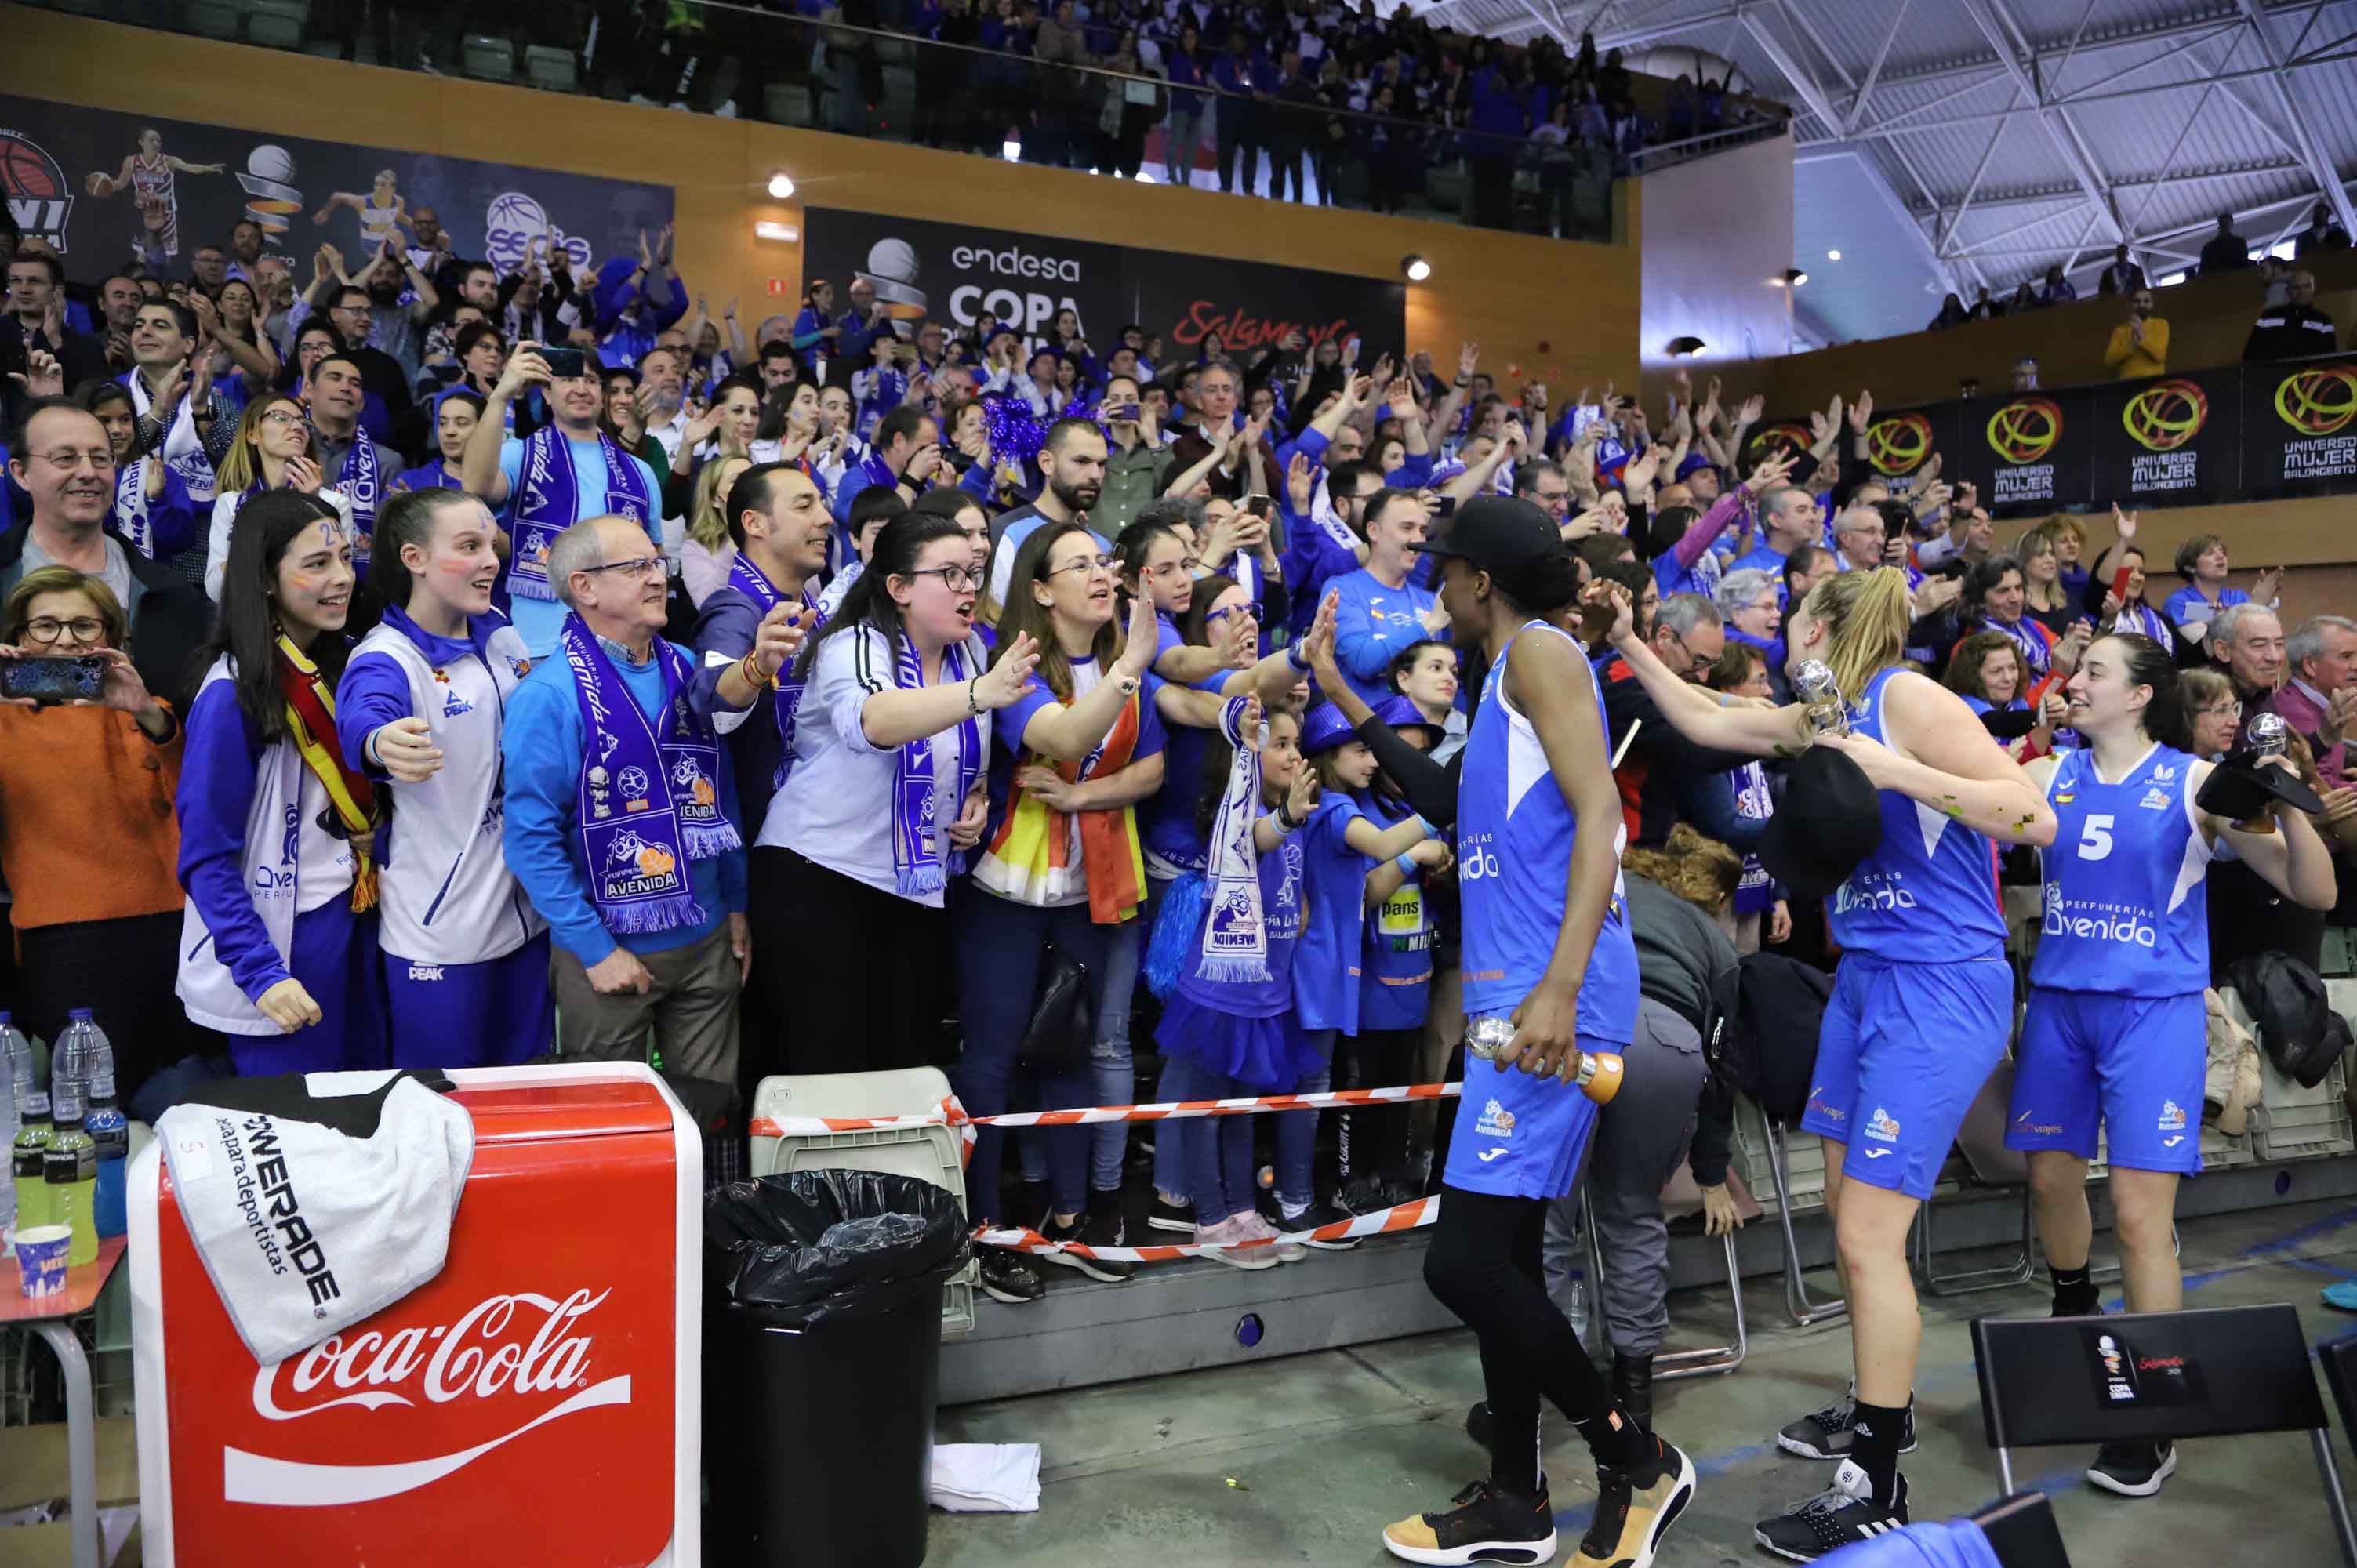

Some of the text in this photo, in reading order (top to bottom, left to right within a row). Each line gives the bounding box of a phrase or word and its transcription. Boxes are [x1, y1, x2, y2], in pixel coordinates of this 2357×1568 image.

[951, 246, 1080, 282] endesa
[949, 285, 1086, 339] COPA
[1173, 301, 1361, 351] Salamnc
[2283, 436, 2357, 453] UNIVERSO
[2132, 452, 2197, 468] UNIVERSO
[2283, 449, 2356, 469] MUJER
[1994, 465, 2054, 480] UNIVERSO
[2132, 463, 2196, 481] MUJER
[1994, 477, 2053, 493] MUJER
[442, 700, 473, 718] PEAK
[680, 804, 716, 818] ENIDA
[2078, 814, 2115, 861] 5
[608, 872, 676, 896] AVENIDA
[1382, 901, 1419, 918] pans
[2065, 900, 2155, 918] PERFUMERÍAS
[409, 966, 445, 981] PEAK
[243, 1116, 341, 1306] WERADE
[252, 1286, 612, 1420] Coca-Cola
